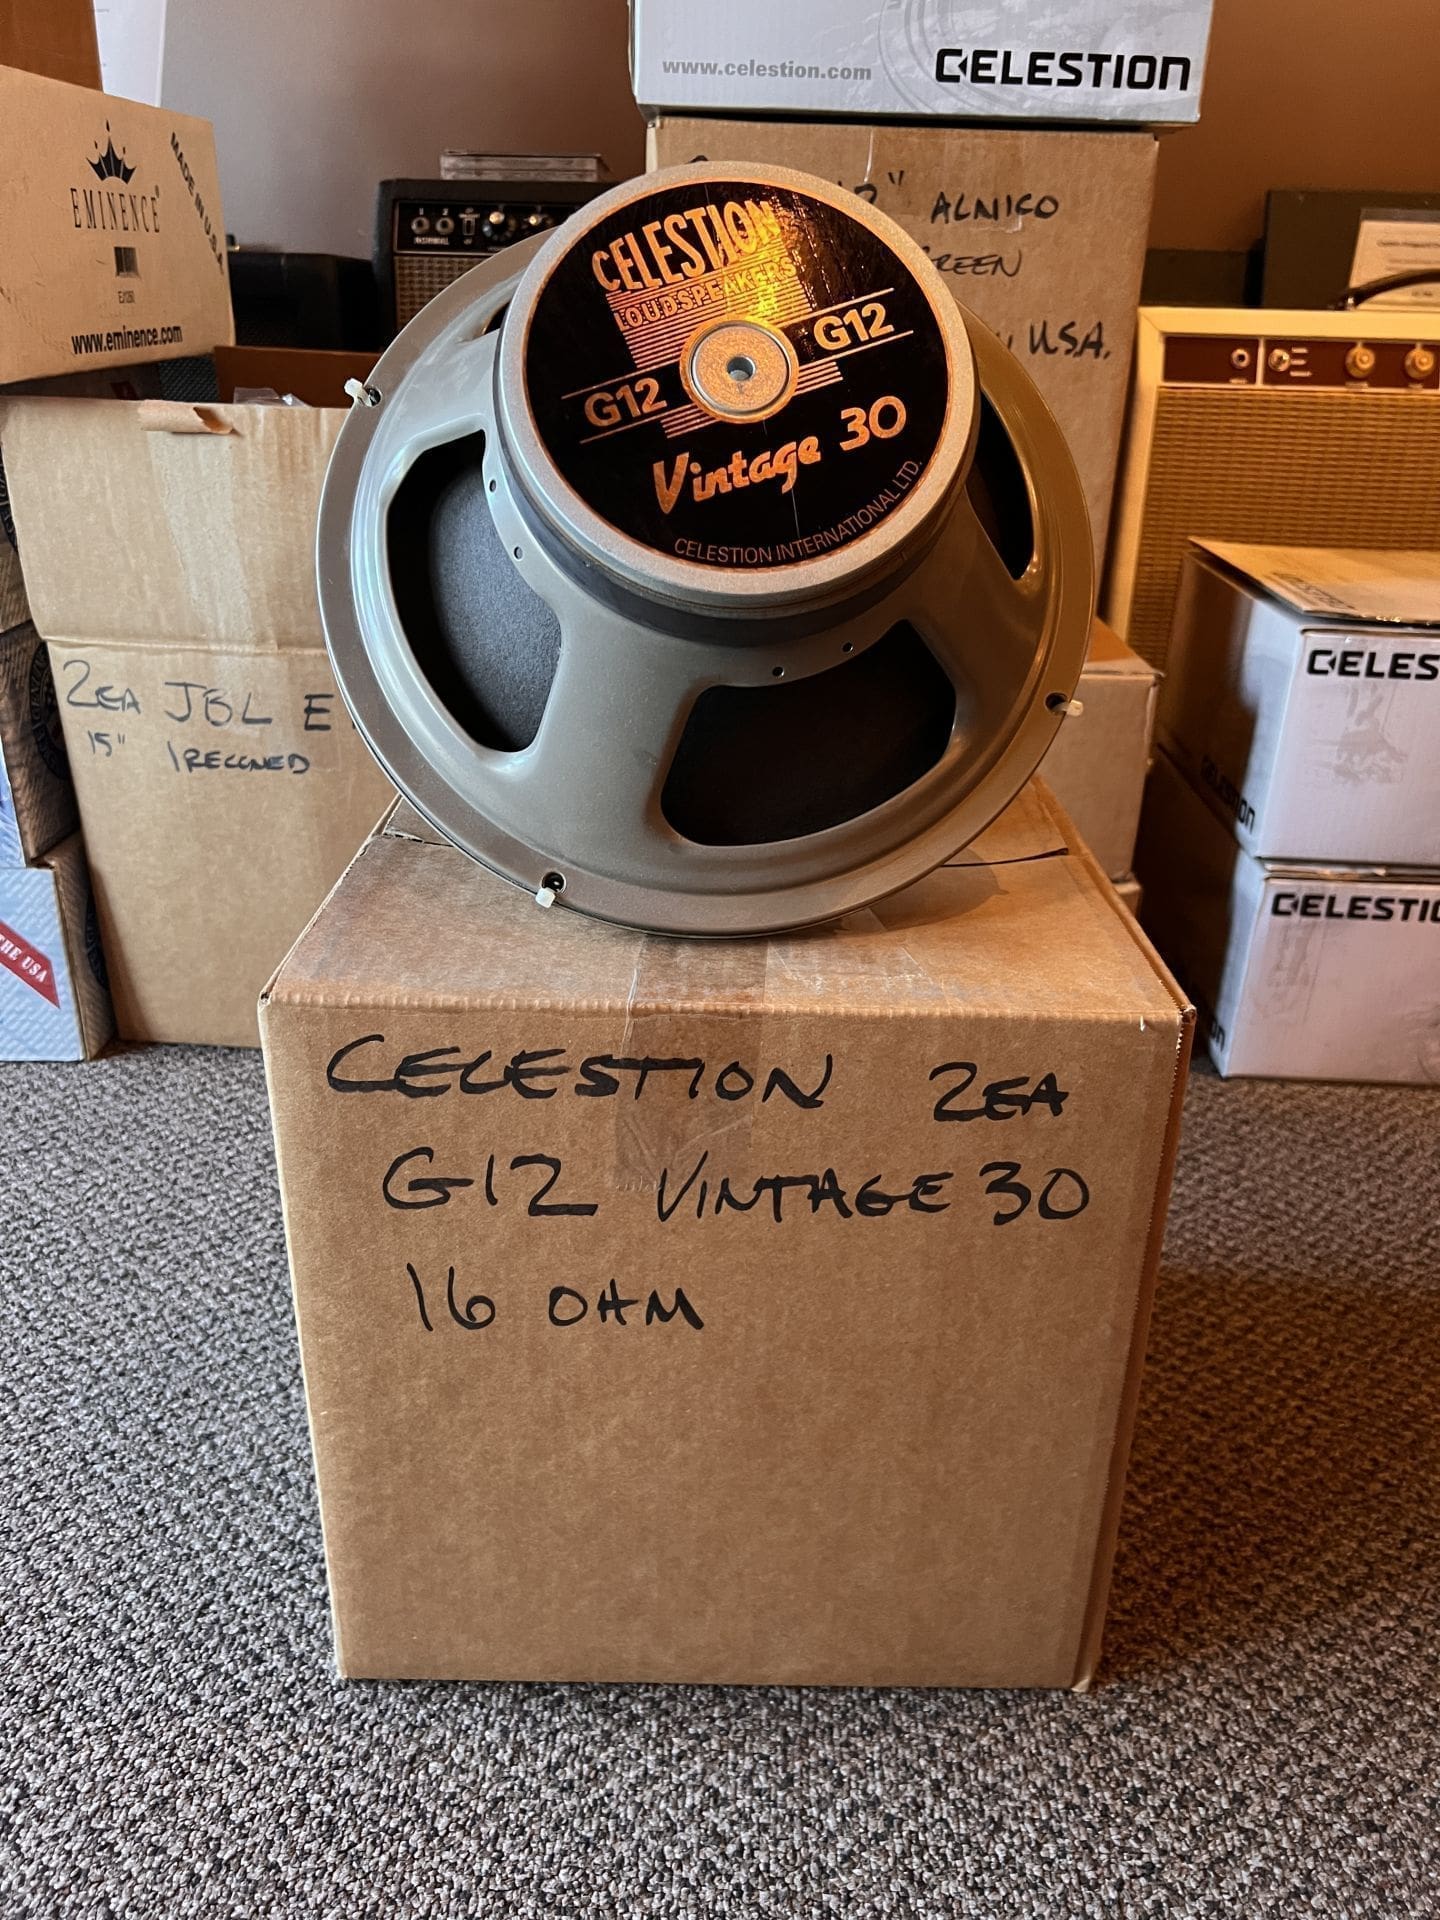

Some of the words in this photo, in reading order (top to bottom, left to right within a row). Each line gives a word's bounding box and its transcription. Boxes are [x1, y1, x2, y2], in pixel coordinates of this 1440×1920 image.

[661, 58, 873, 82] www.celestion.com
[935, 47, 1192, 92] CELESTION
[170, 132, 195, 196] MADE
[70, 188, 160, 233] EMINENCE
[930, 191, 1060, 225] ALNICO
[591, 199, 783, 292] CELESTION
[613, 256, 797, 331] LOUDSPEAKERS
[71, 324, 184, 355] www.eminence.com
[812, 302, 895, 352] G12
[583, 377, 668, 427] G12
[652, 435, 822, 515] Vintage
[839, 394, 908, 452] 30
[673, 536, 773, 564] CELESTION
[775, 489, 900, 560] INTERNATIONAL
[894, 457, 924, 491] LTD.
[1306, 649, 1440, 681] CELES
[164, 682, 273, 727] JBL
[87, 730, 126, 758] 15"
[21, 955, 48, 984] USA
[326, 1034, 833, 1109] CELESTION
[382, 1147, 600, 1217] G12
[656, 1151, 953, 1223] VINTAGE
[978, 1161, 1091, 1226] 30
[406, 1262, 496, 1332] 16
[548, 1278, 705, 1331] OHM
